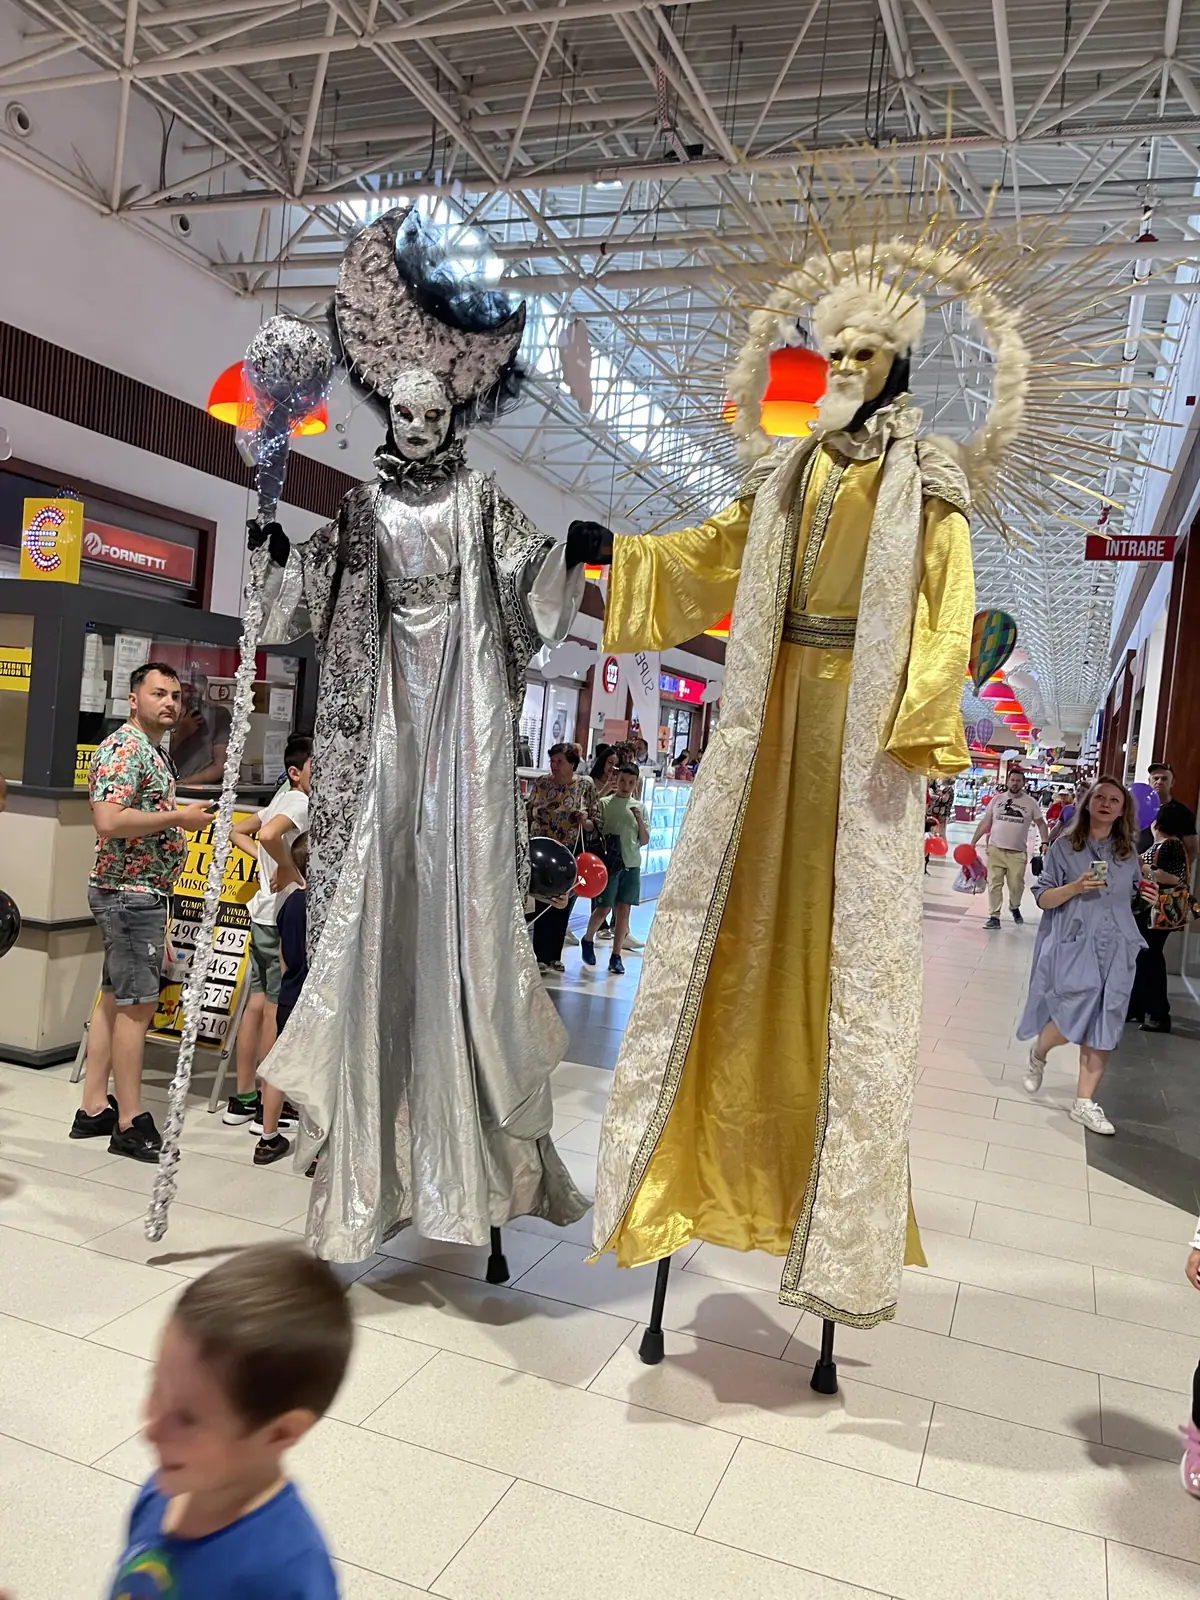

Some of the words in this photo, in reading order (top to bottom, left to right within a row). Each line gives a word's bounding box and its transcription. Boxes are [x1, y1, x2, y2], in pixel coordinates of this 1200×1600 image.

[101, 544, 167, 570] FORNETTI
[1105, 540, 1166, 557] INTRARE
[226, 907, 251, 918] VINDE
[170, 923, 200, 941] 490
[216, 930, 247, 948] 495
[207, 959, 238, 977] 462
[199, 1016, 228, 1036] 510
